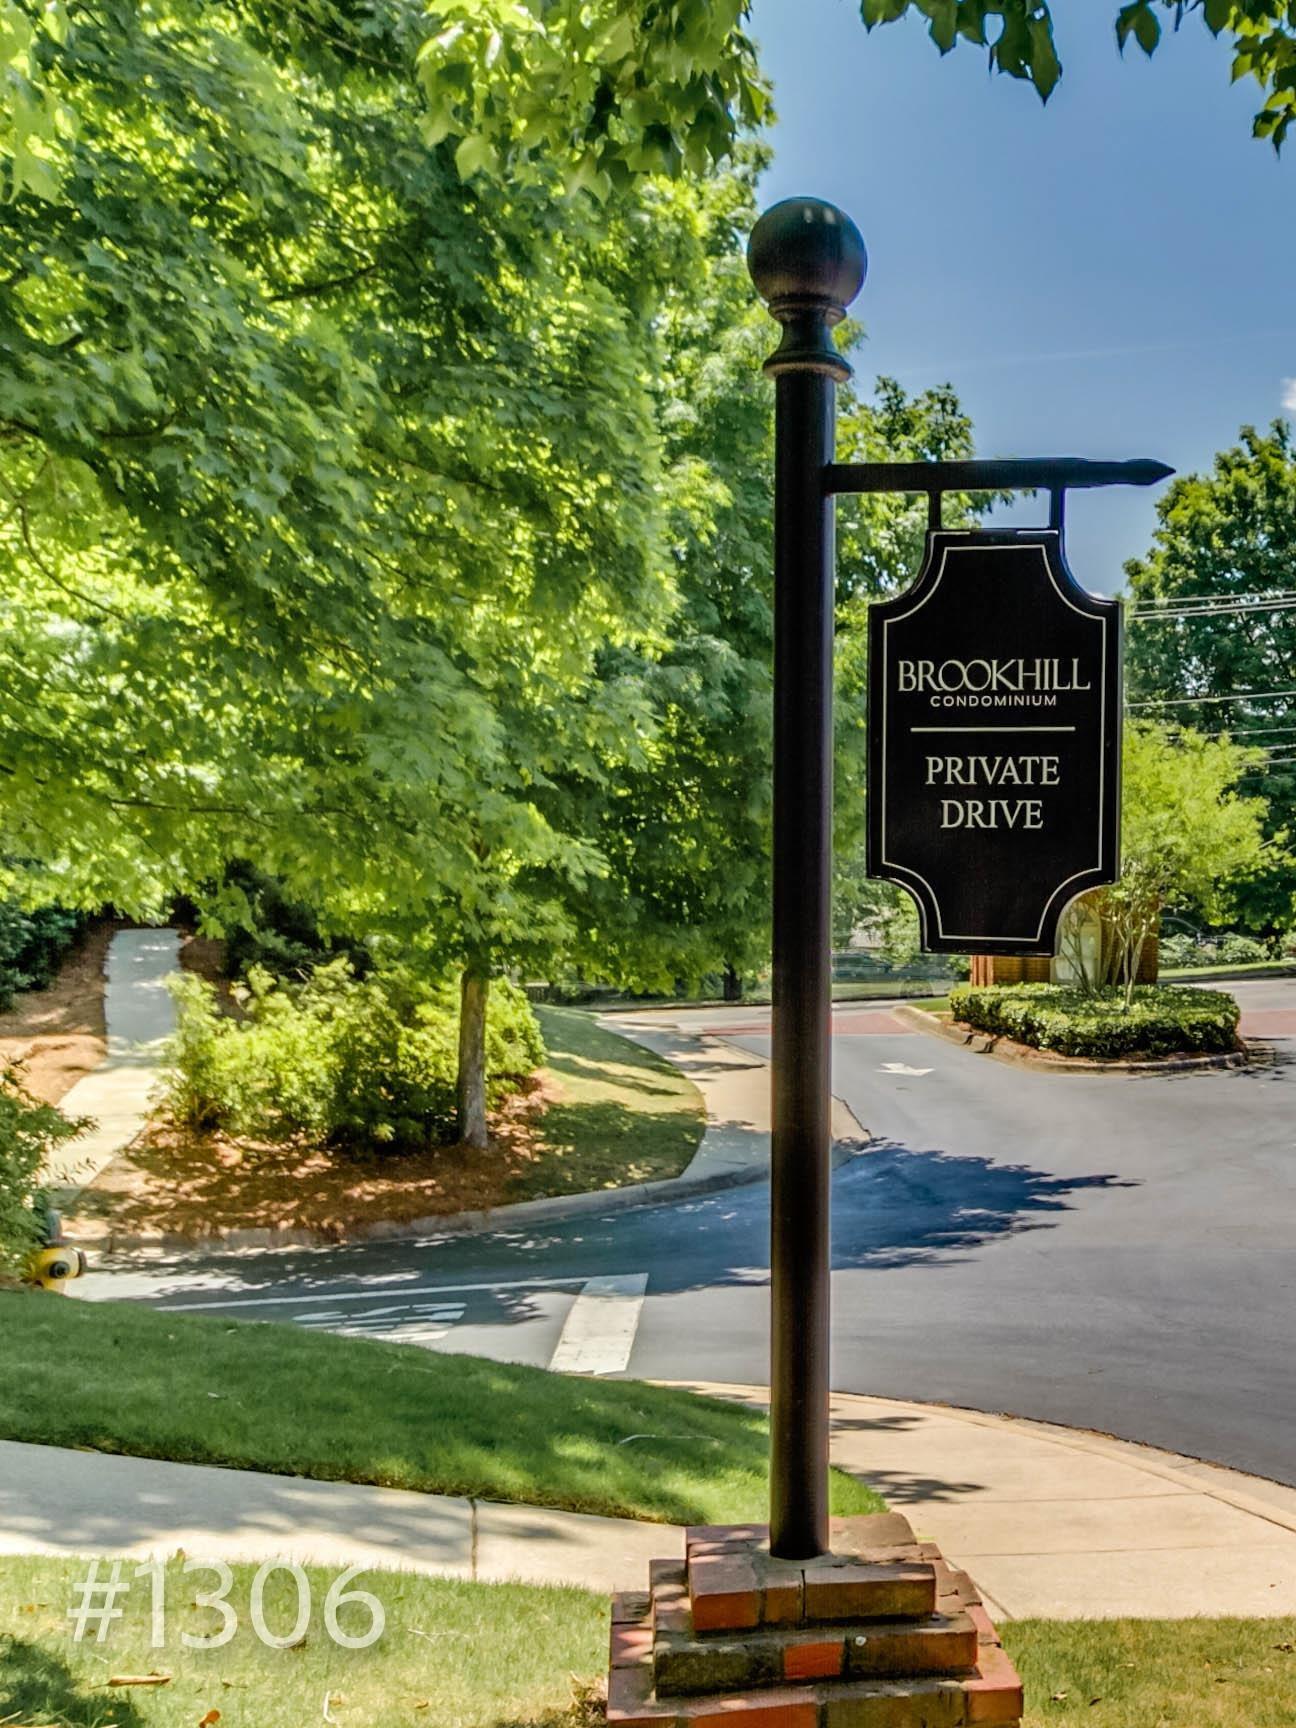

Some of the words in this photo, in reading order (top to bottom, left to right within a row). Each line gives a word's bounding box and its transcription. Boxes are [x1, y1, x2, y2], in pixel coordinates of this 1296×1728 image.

[898, 658, 1091, 692] BROOKHILL
[929, 694, 1057, 708] CONDOMINIUM
[925, 756, 1060, 785] PRIVATE
[940, 799, 1044, 829] DRIVE
